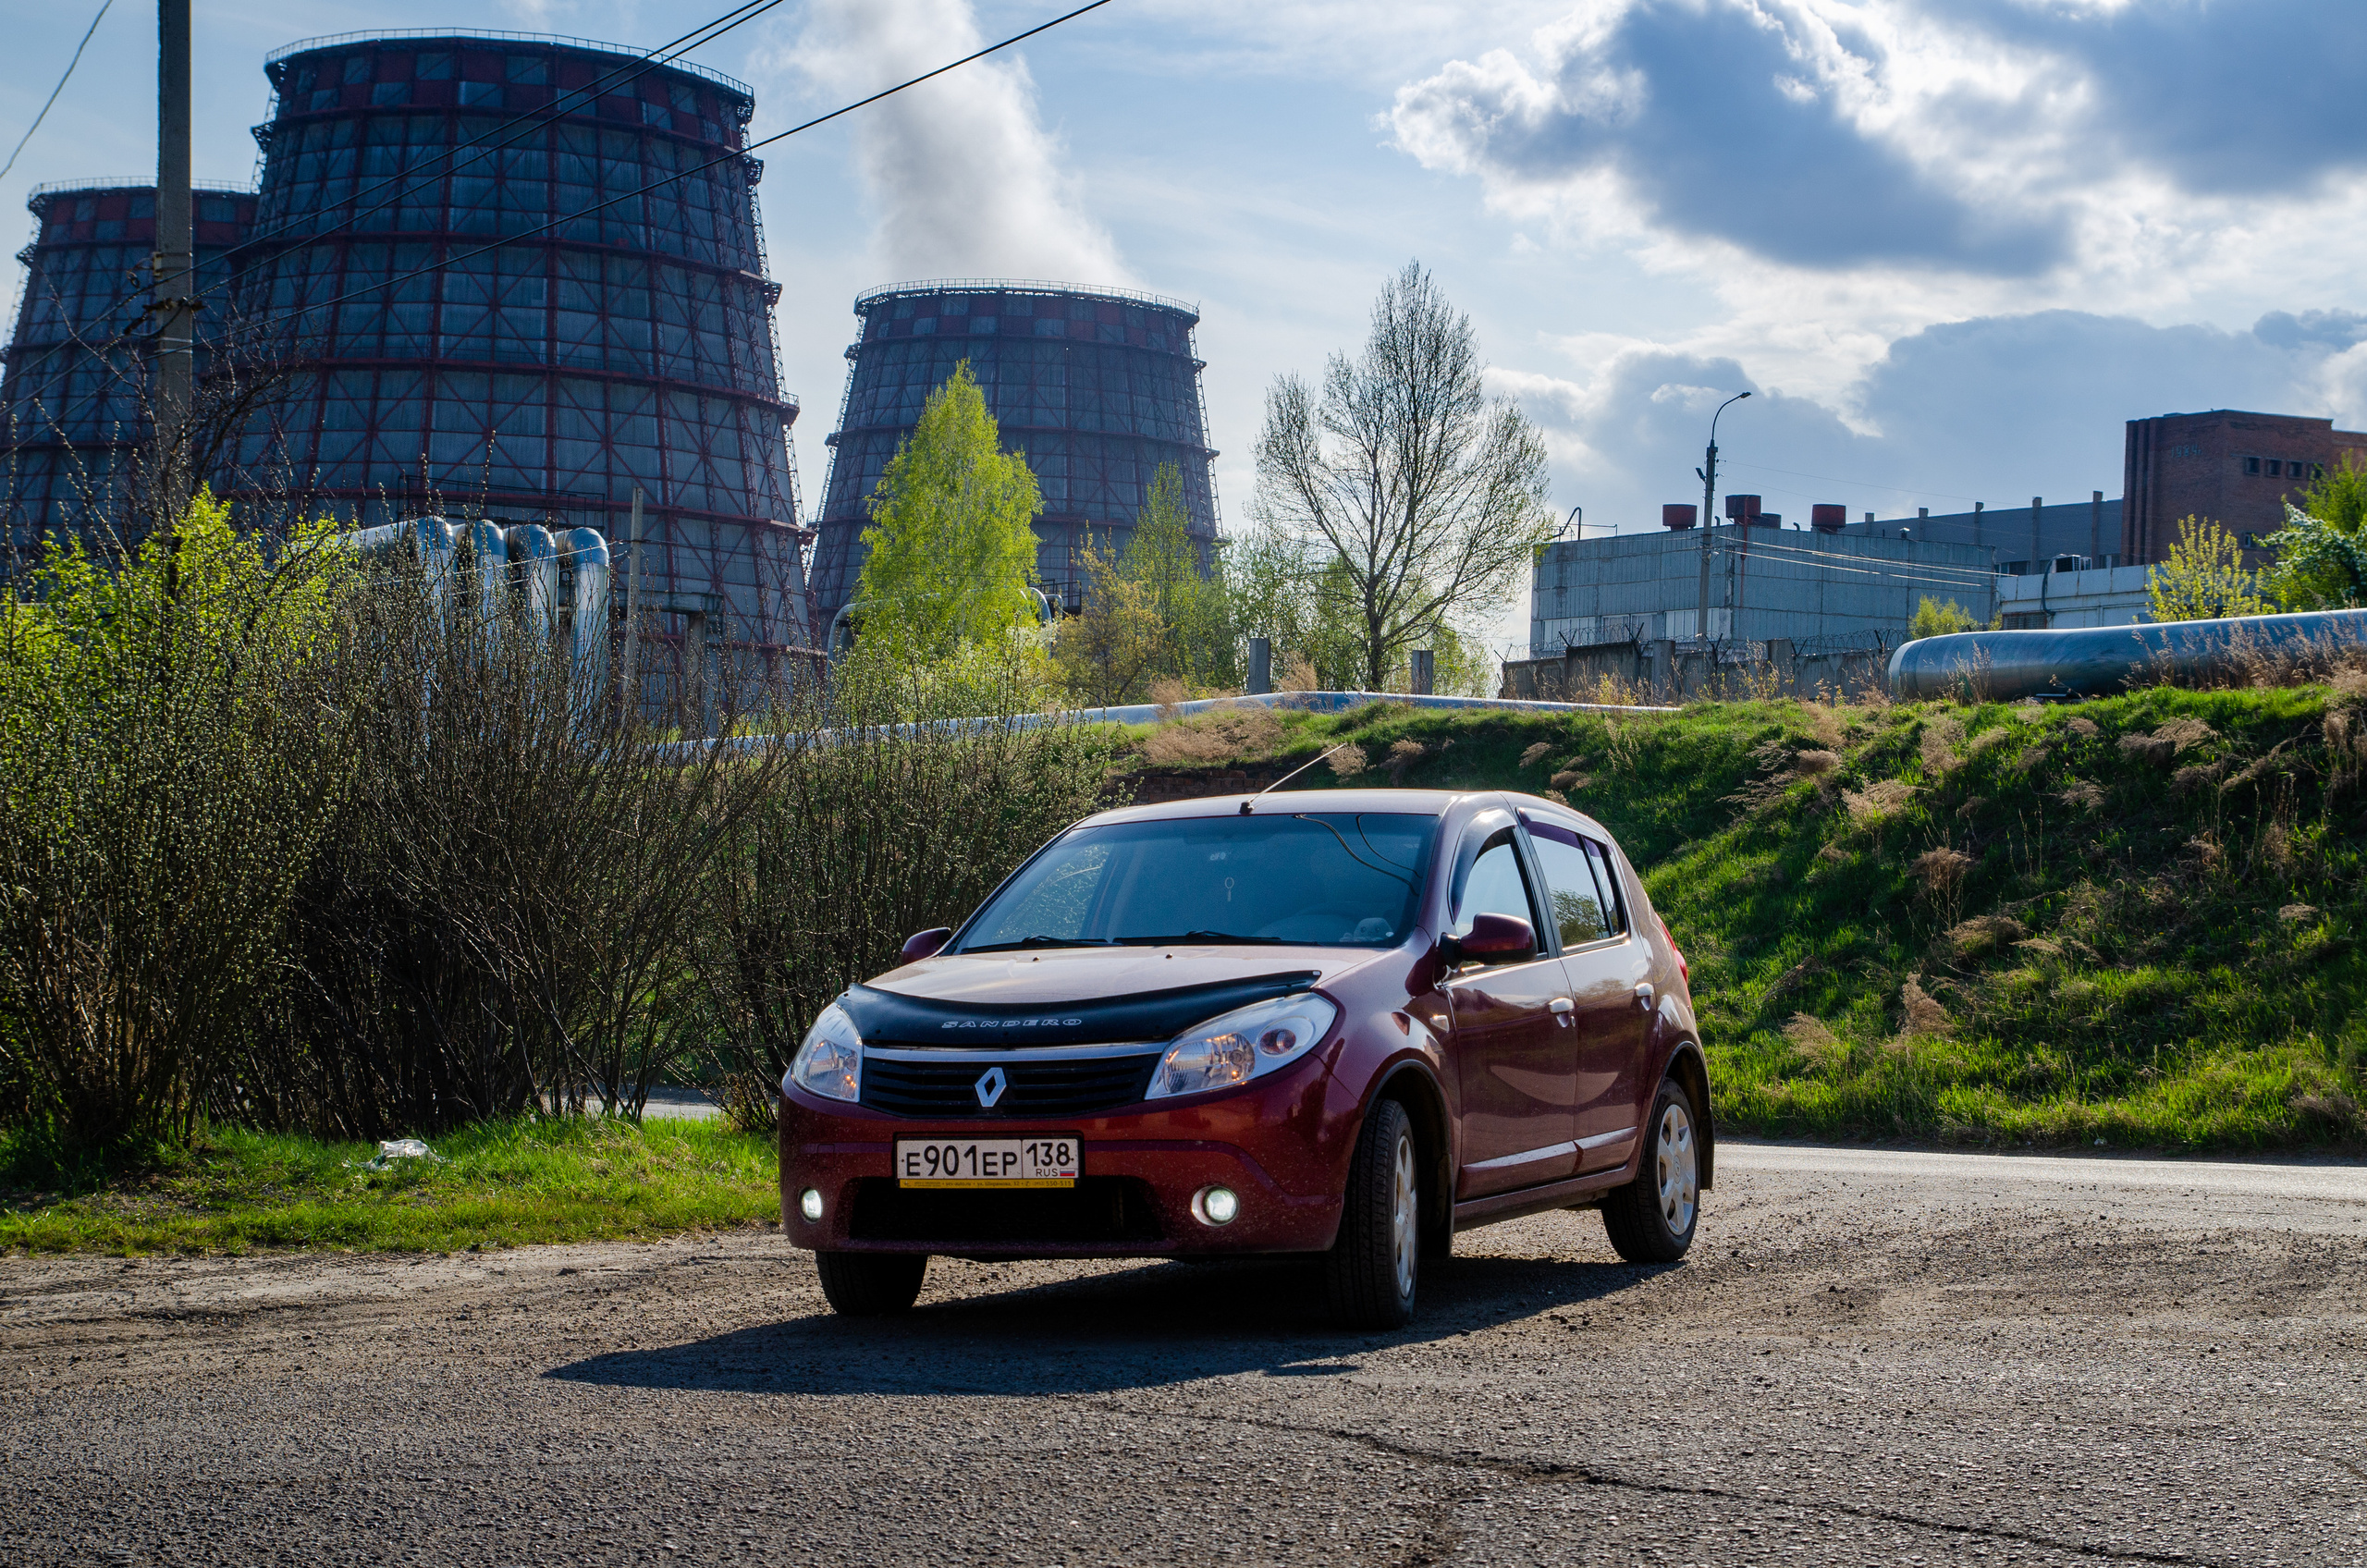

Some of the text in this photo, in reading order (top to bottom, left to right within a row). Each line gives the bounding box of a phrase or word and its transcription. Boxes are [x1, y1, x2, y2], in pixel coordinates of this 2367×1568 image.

[941, 1019, 1082, 1028] SANDERO
[1025, 1142, 1071, 1167] 138
[1036, 1168, 1059, 1177] RUS
